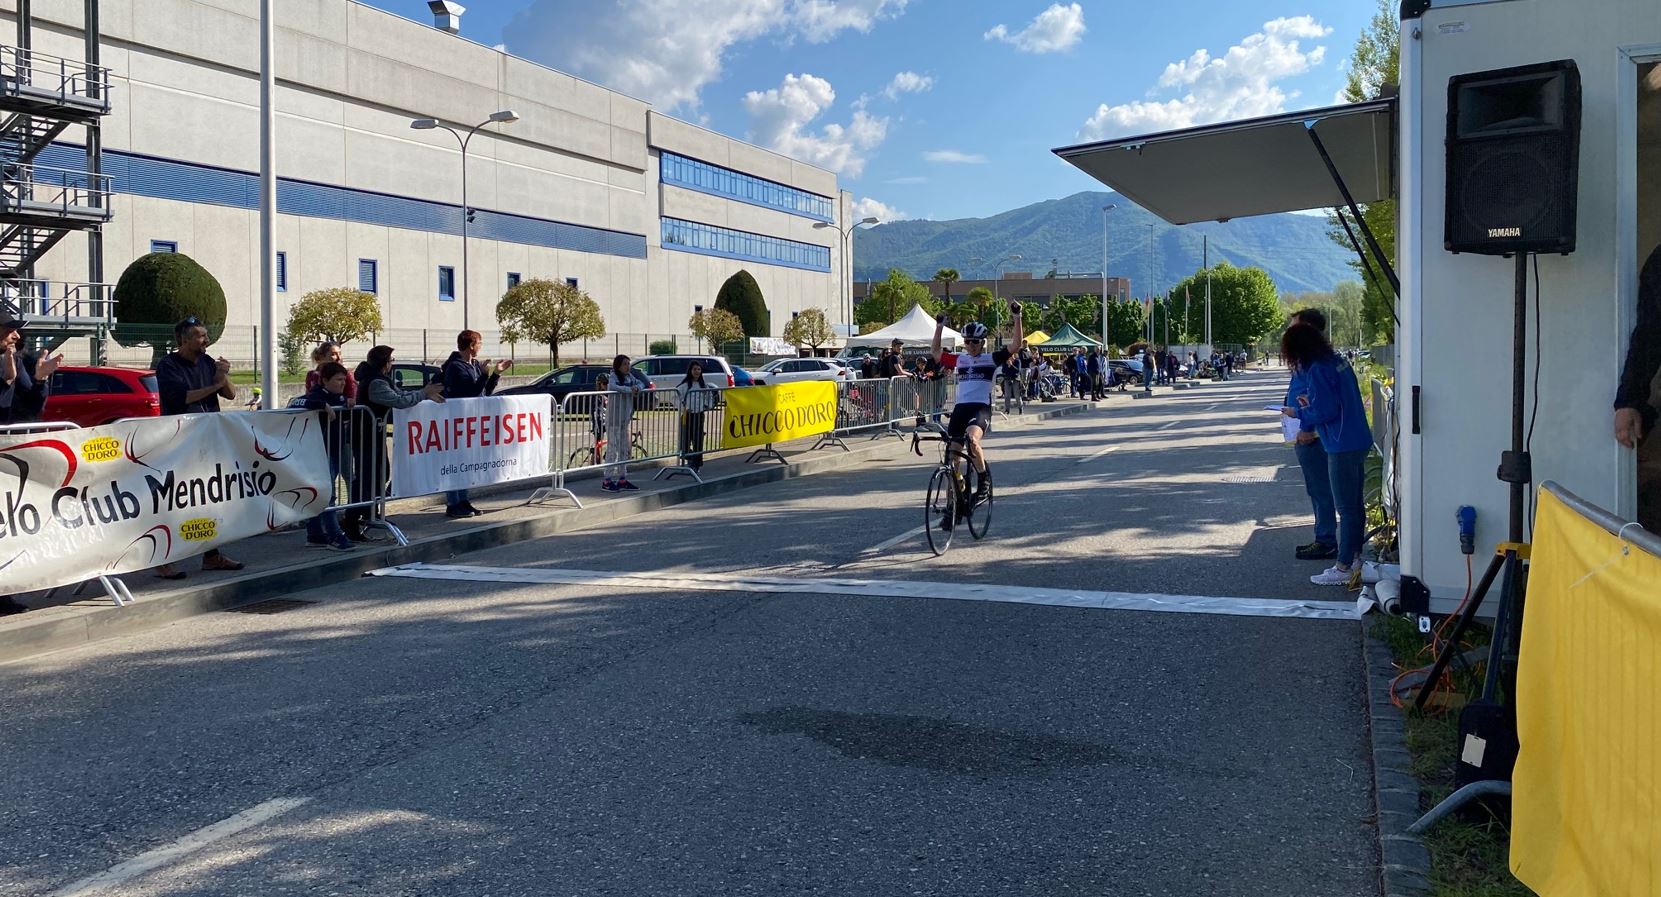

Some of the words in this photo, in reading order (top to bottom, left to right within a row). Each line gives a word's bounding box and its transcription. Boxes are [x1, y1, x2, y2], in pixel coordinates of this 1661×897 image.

[1488, 227, 1520, 237] YAMAHA
[729, 408, 795, 438] CHICCO
[407, 412, 542, 455] RAIFFEISEN
[83, 440, 119, 453] CHICCO
[440, 464, 458, 476] della
[459, 457, 518, 473] Campagnadorna
[51, 481, 141, 529] Club
[144, 460, 277, 514] Mendrisio
[181, 521, 216, 533] CHICCO
